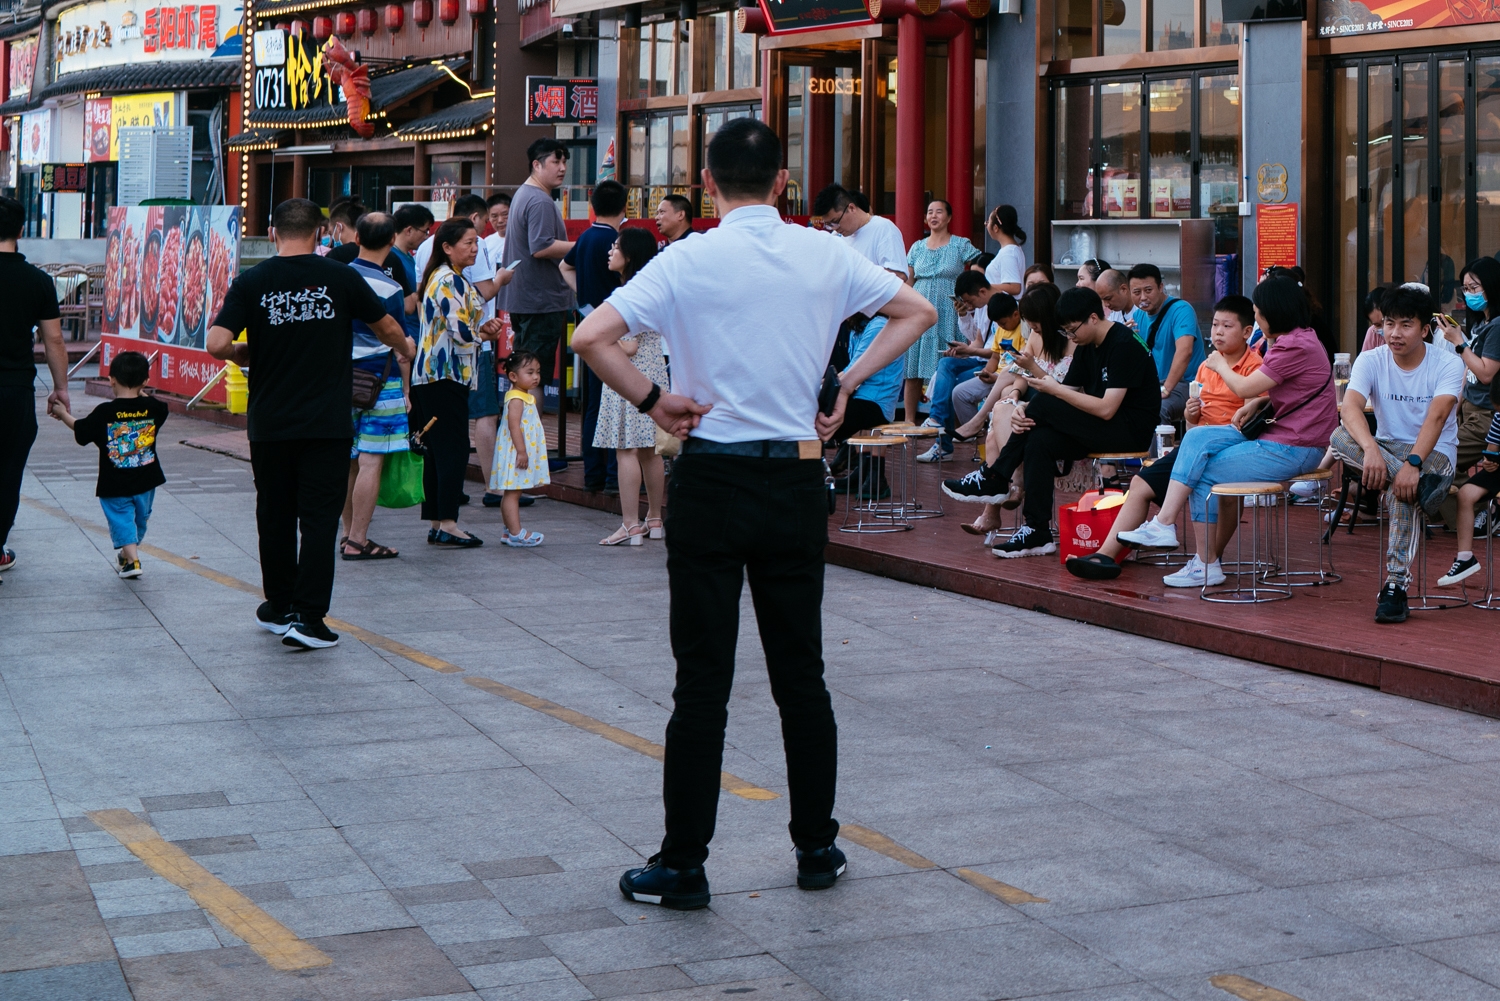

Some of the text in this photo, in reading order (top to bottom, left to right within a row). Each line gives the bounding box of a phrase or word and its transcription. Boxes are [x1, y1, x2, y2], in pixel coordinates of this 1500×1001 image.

[143, 4, 218, 53] 岳阳虾尾
[255, 67, 286, 109] 0731
[534, 84, 598, 119] 烟酒
[260, 285, 333, 310] 行虾仗义
[267, 302, 336, 326] 聚味瞿记
